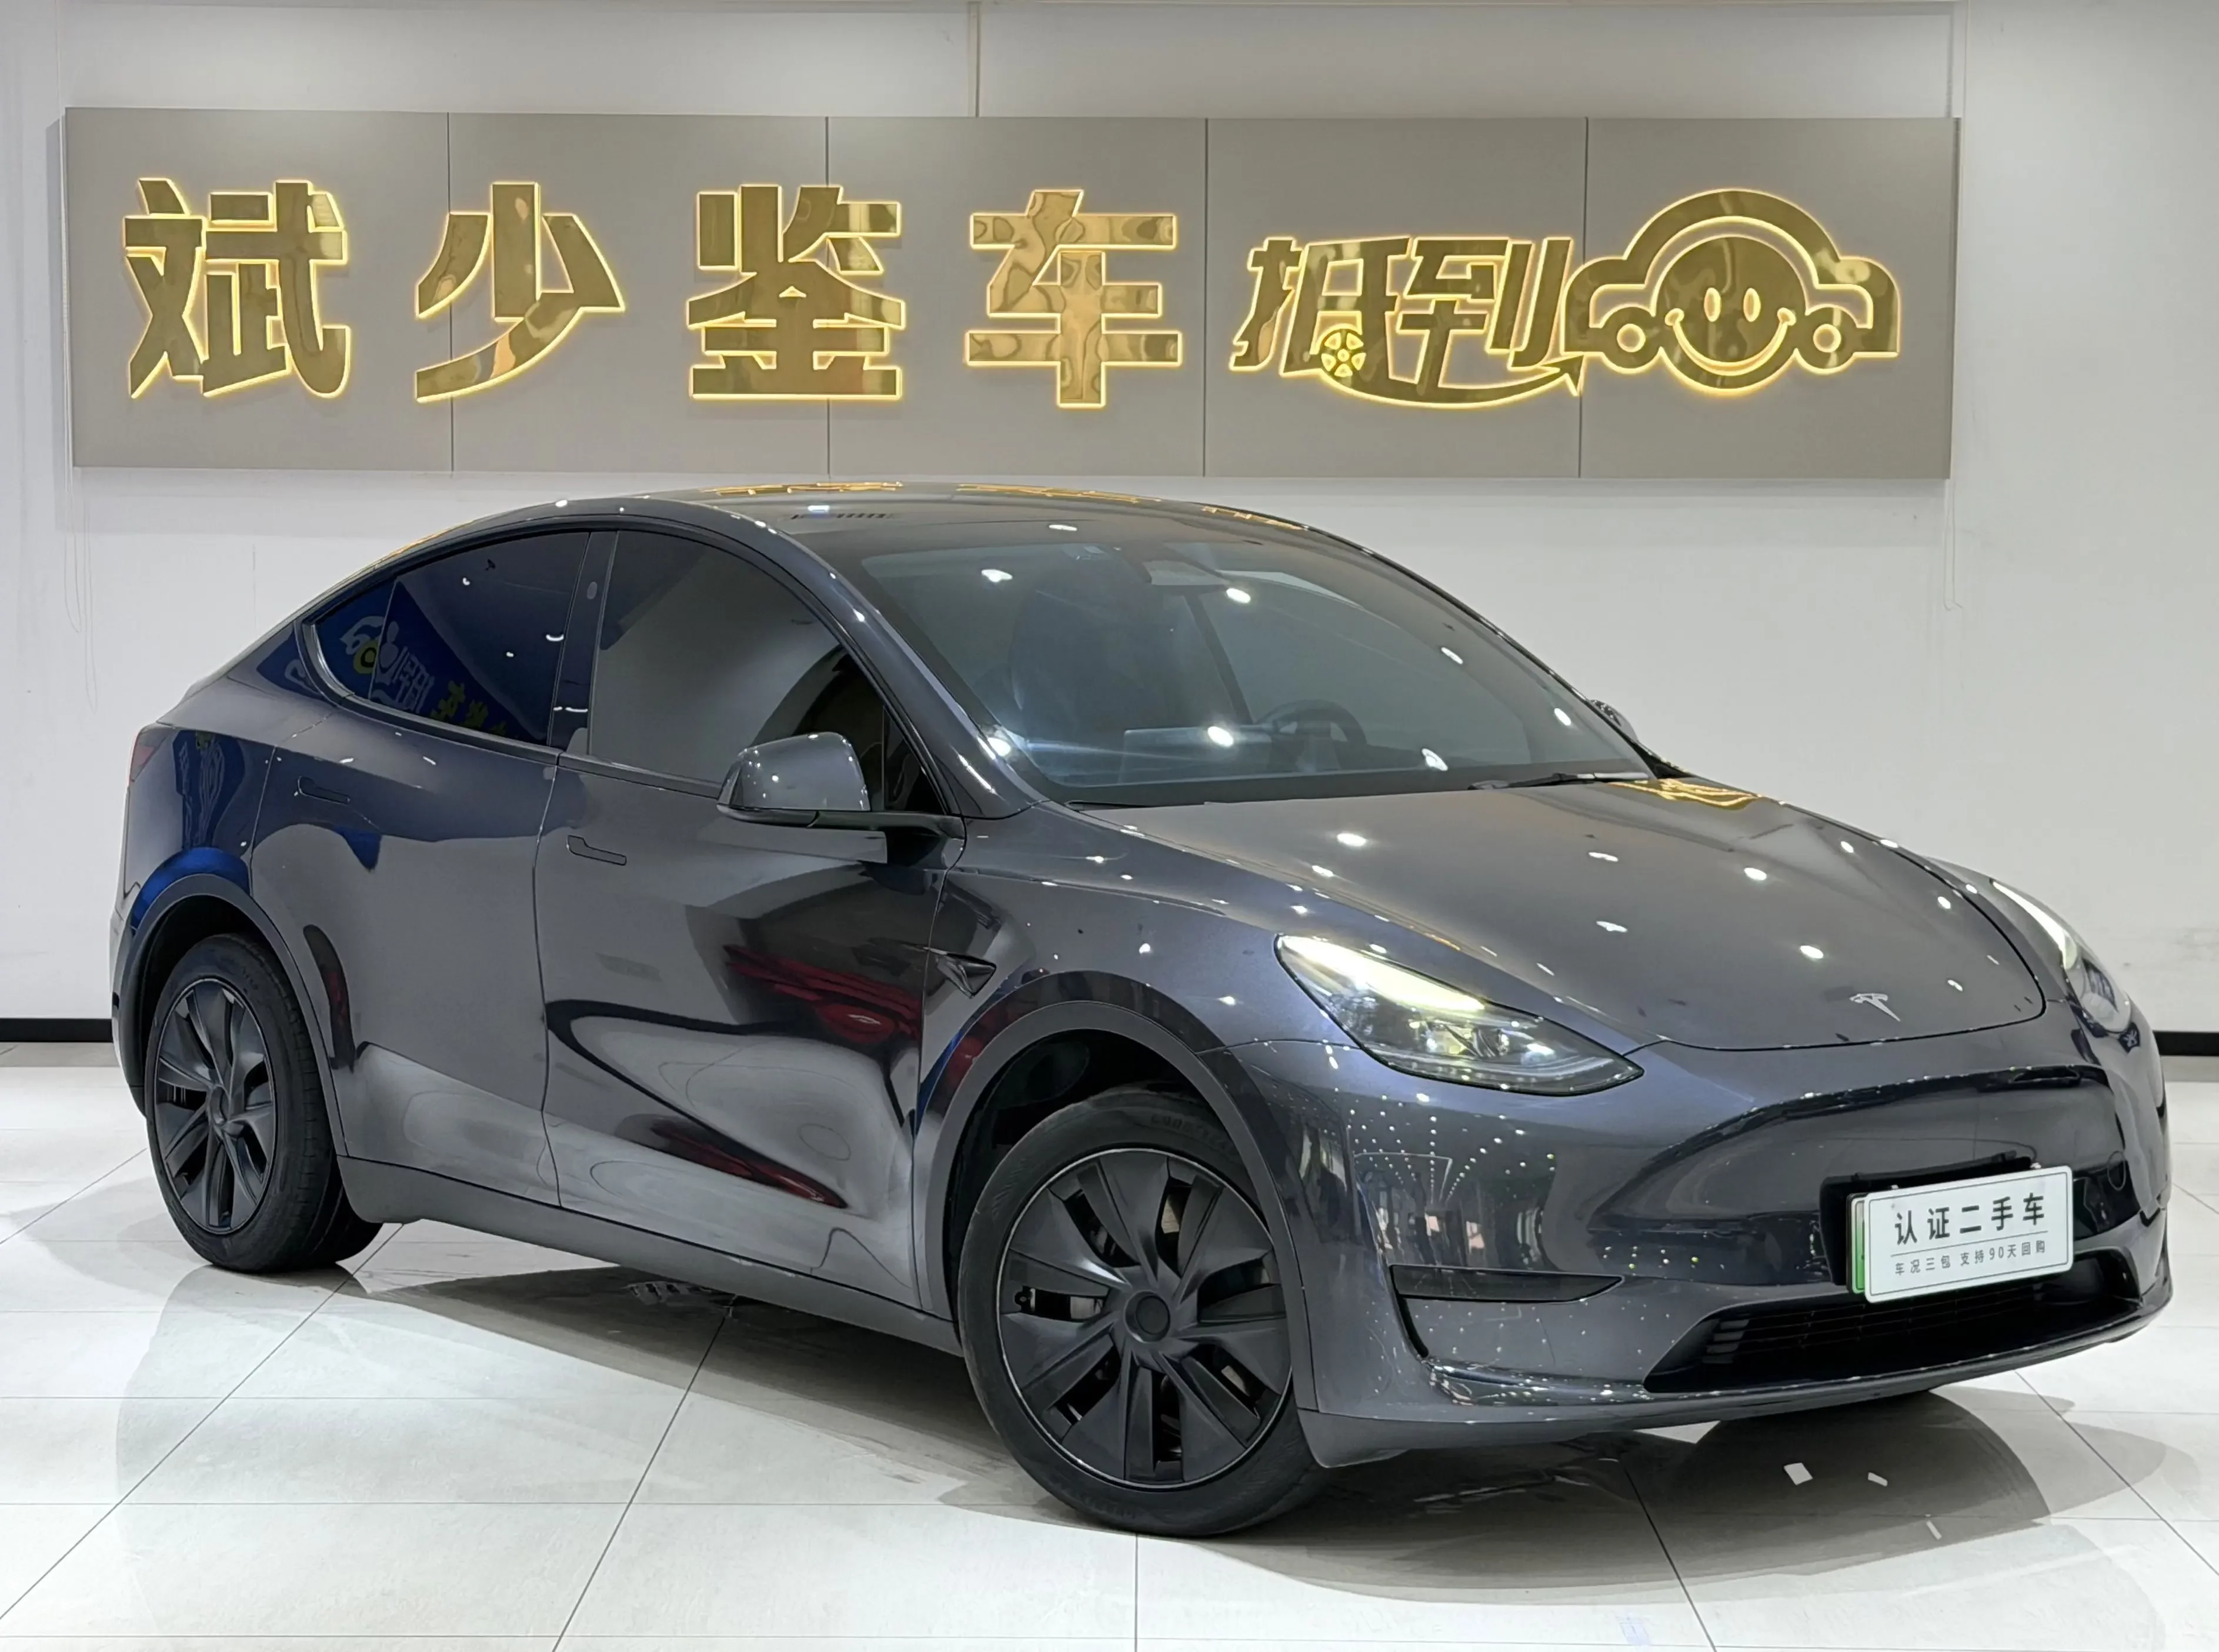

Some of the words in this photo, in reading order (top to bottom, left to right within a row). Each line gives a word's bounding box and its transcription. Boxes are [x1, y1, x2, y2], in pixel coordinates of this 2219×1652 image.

[124, 177, 1182, 409] 斌少鉴车
[1894, 1193, 2044, 1245] 认证二手车
[1895, 1255, 1951, 1275] 车况三包
[1960, 1240, 2045, 1266] 支持90天回购
